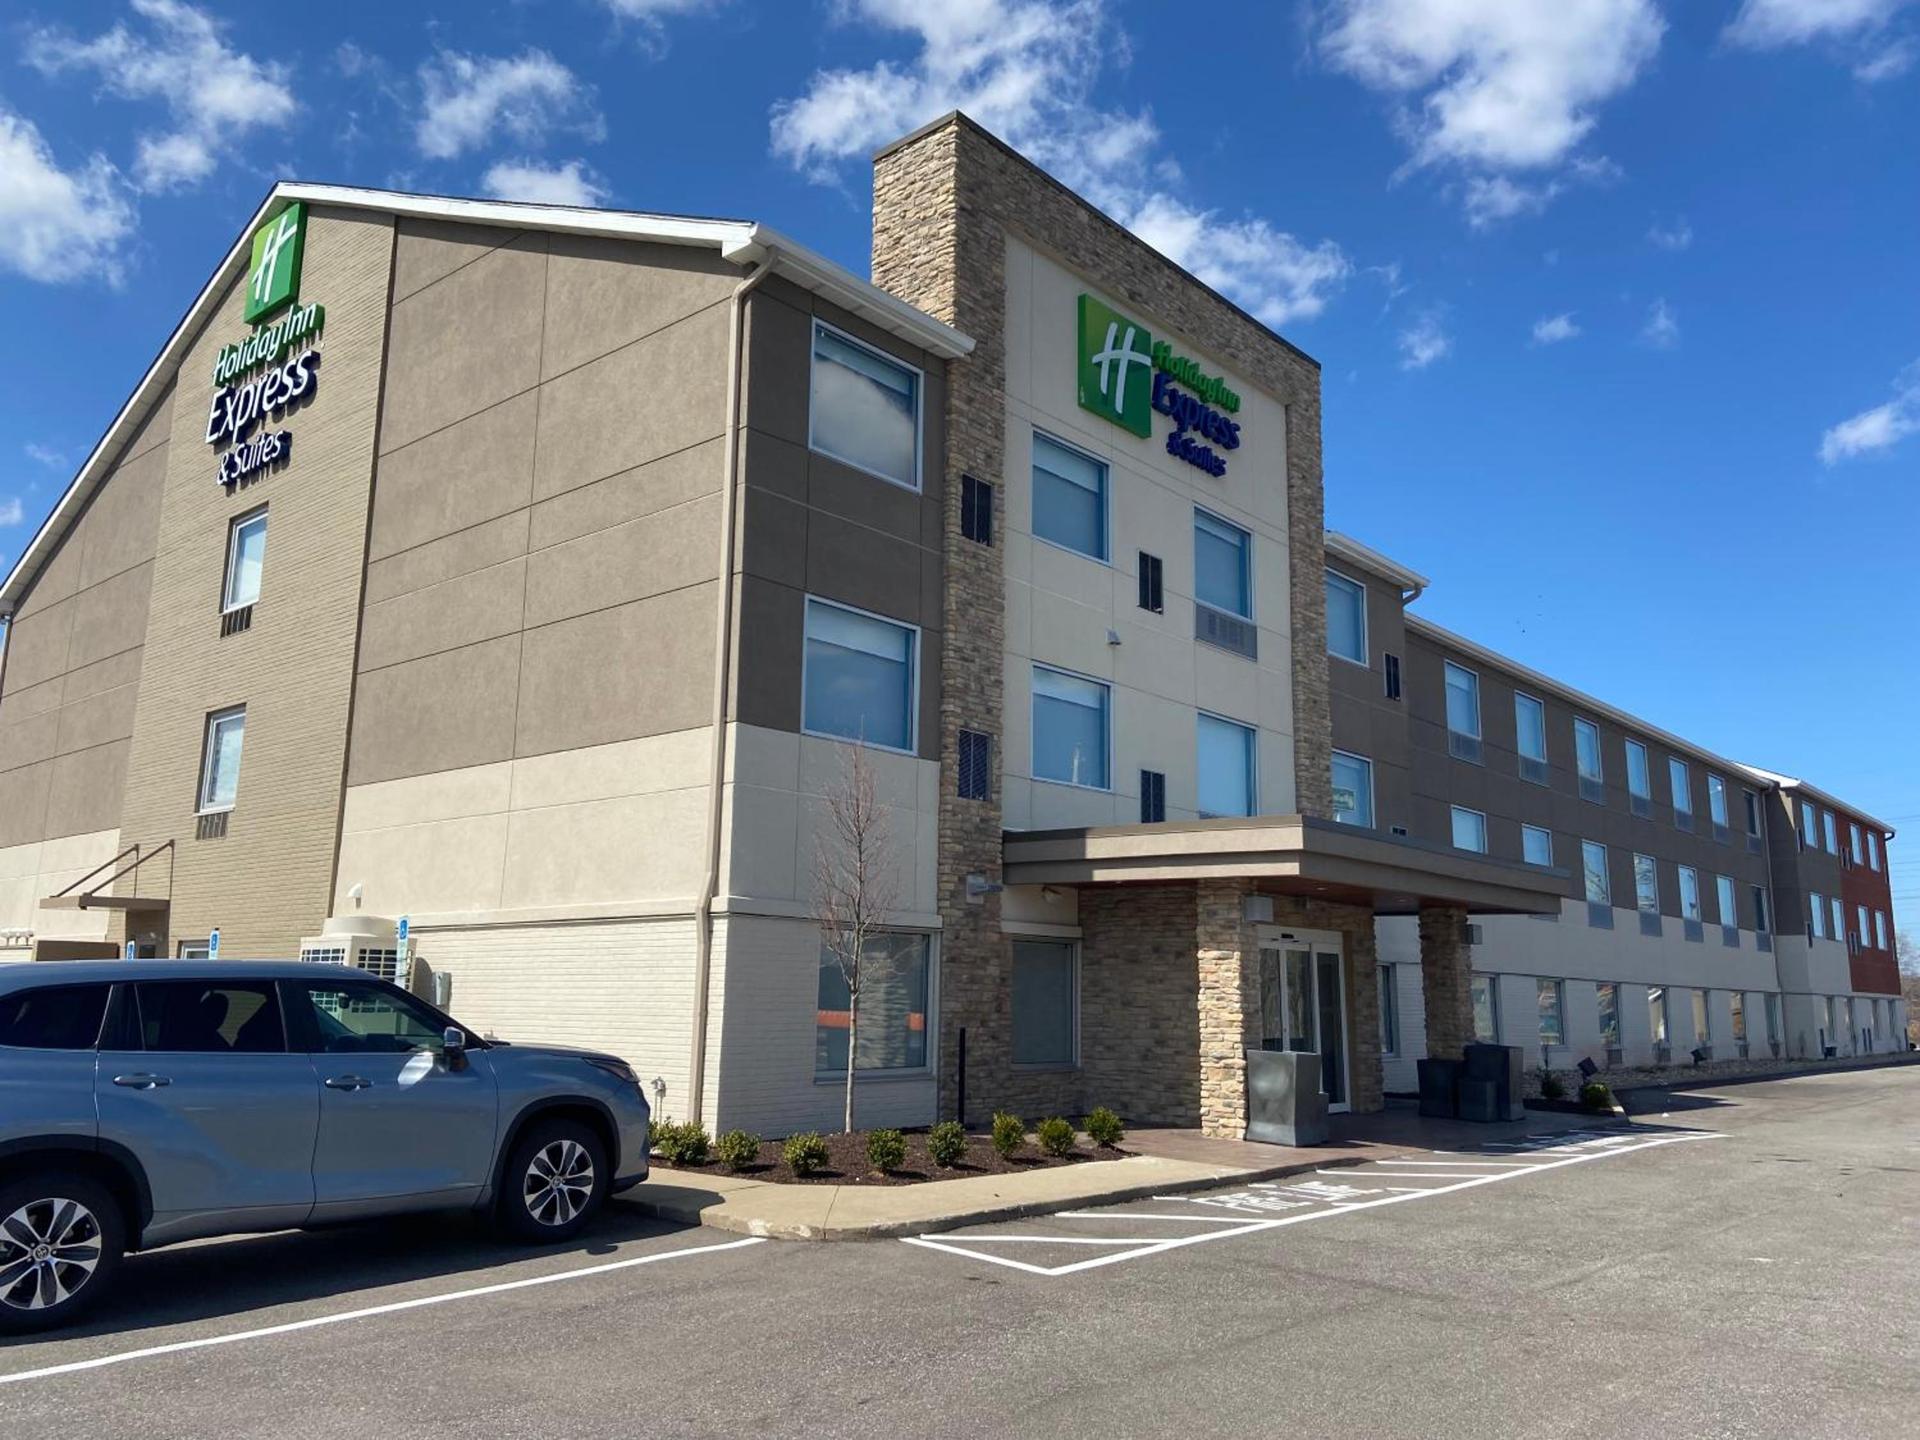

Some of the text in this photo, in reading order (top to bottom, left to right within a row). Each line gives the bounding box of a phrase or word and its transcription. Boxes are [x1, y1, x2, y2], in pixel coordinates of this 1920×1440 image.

[213, 302, 318, 386] Holiday Inn
[1152, 341, 1220, 403] Holiday
[205, 350, 312, 442] Express
[1152, 373, 1241, 450] Express
[217, 430, 283, 485] & Suites
[1179, 437, 1227, 478] Suites
